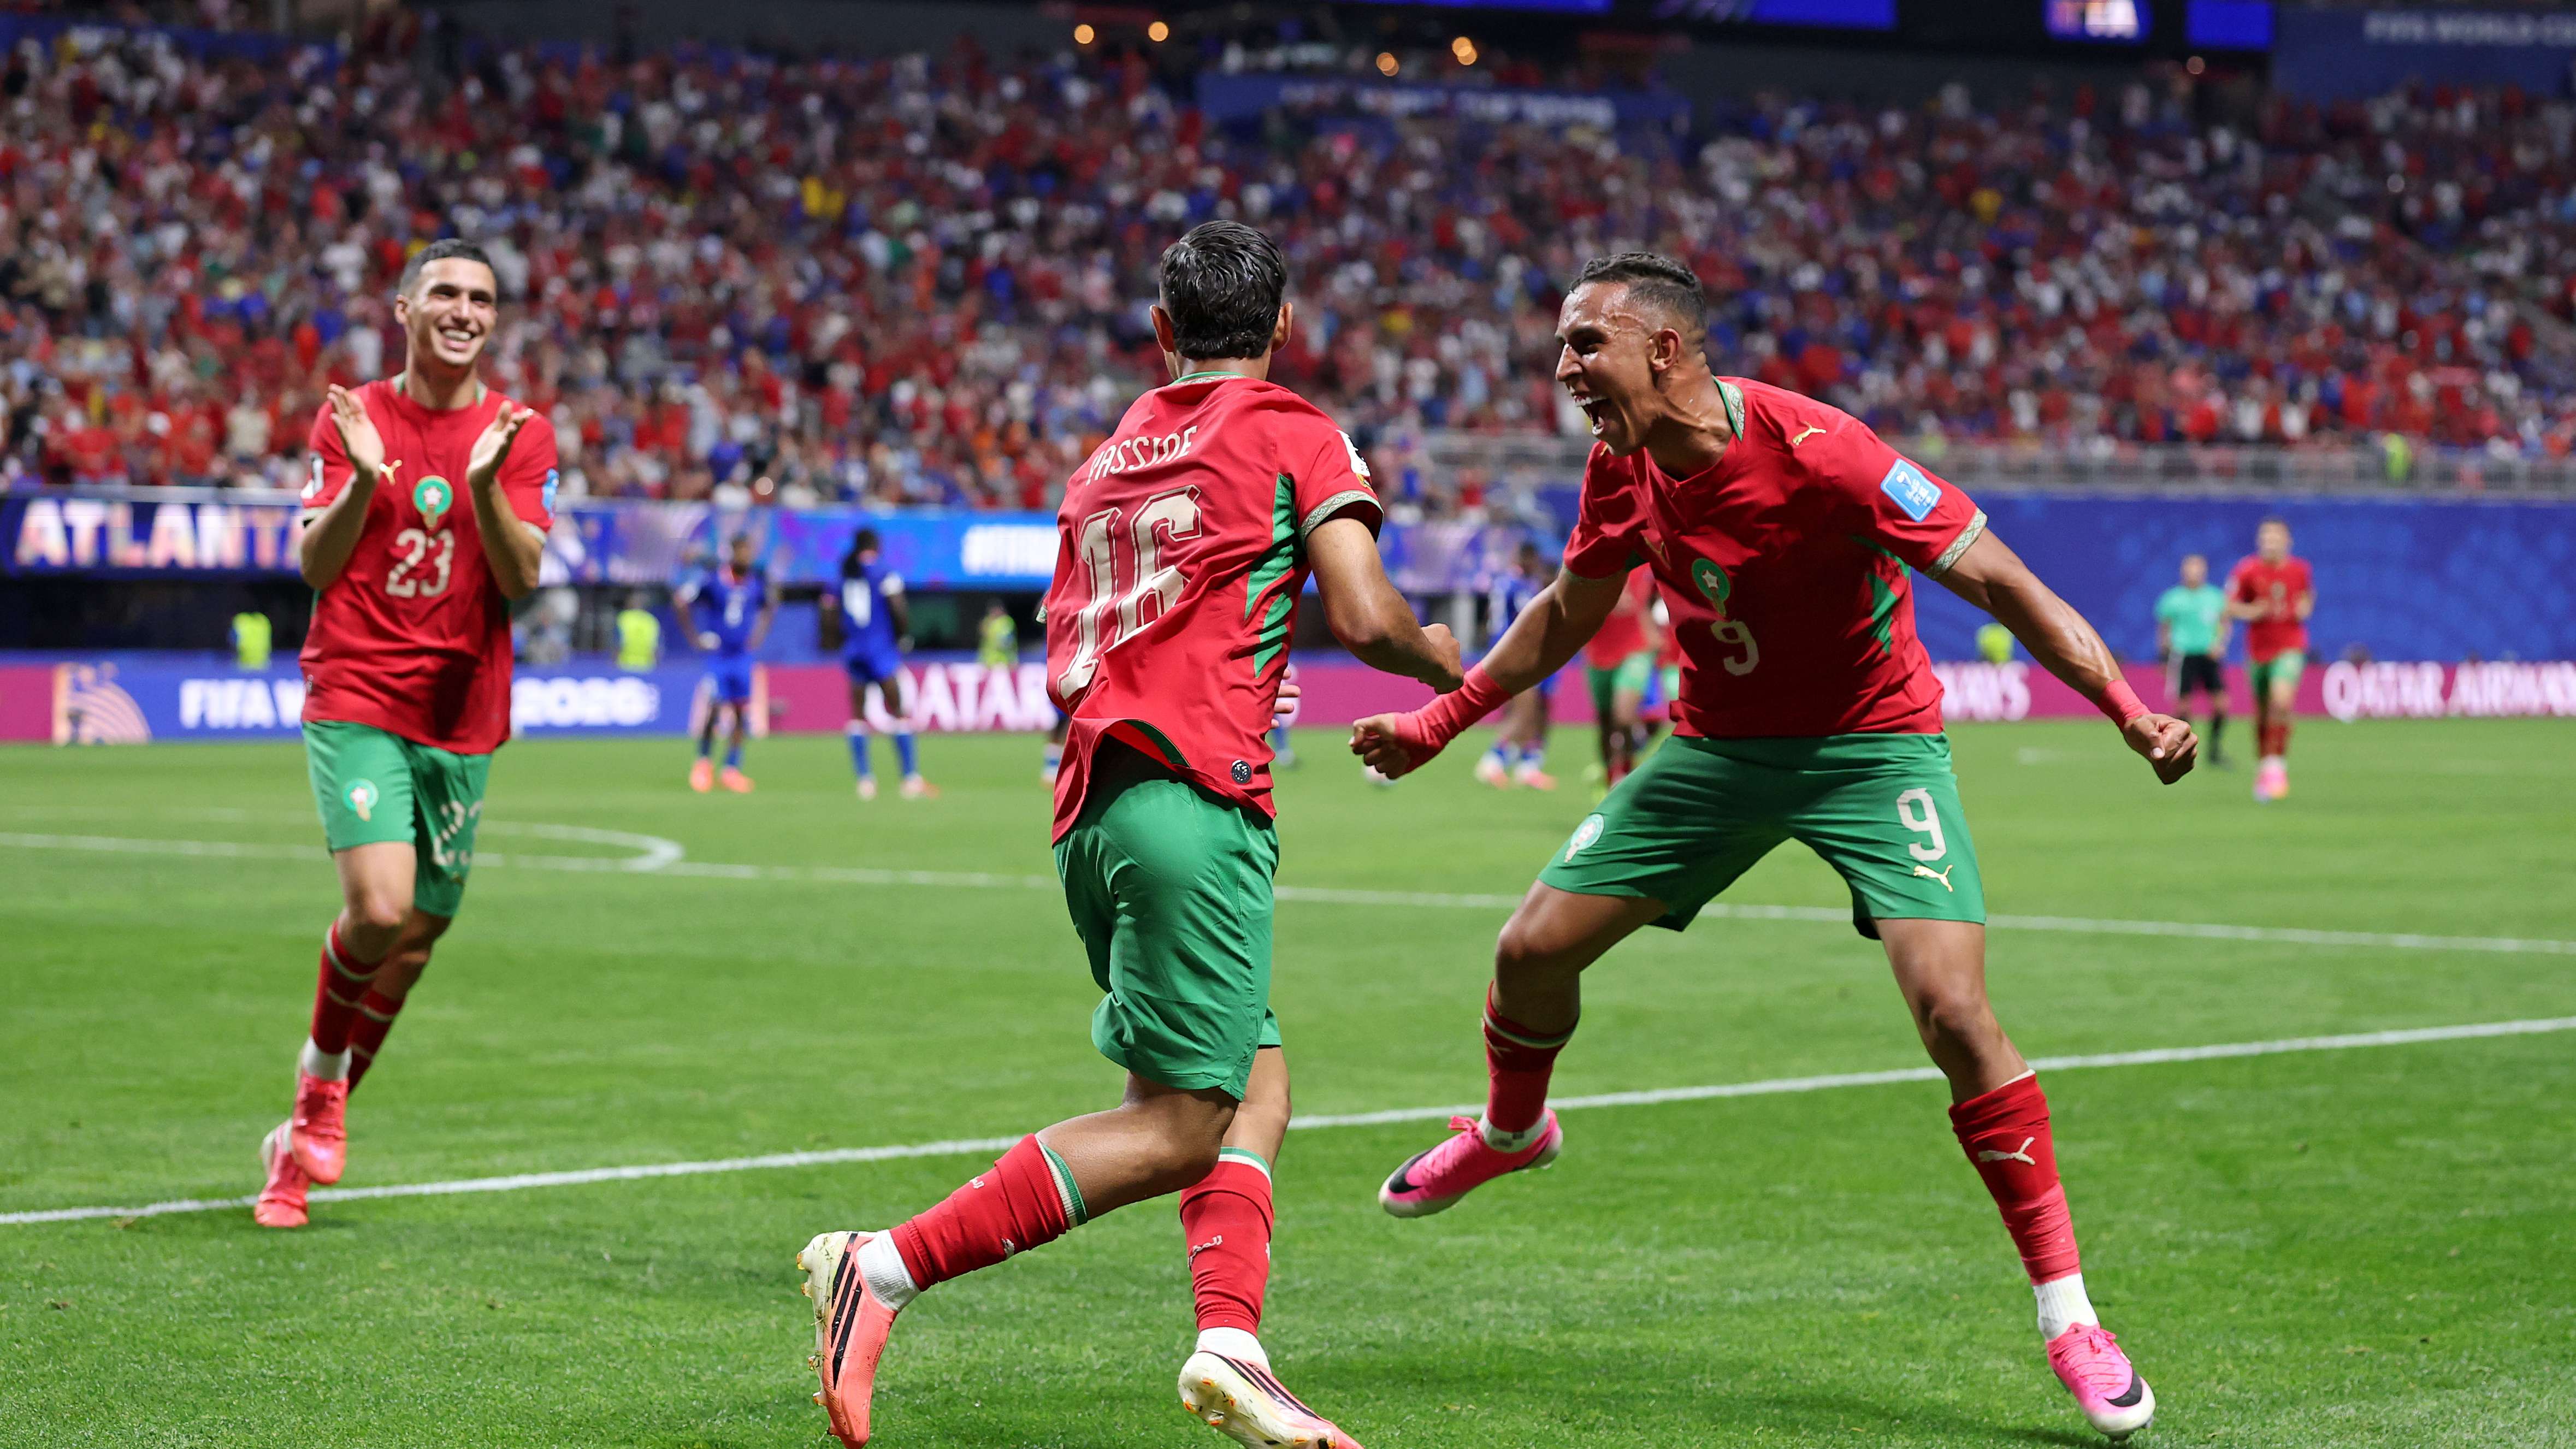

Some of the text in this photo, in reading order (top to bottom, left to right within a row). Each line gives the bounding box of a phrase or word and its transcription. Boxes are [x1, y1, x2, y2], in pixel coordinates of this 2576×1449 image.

[385, 528, 454, 598] 23
[1057, 484, 1202, 705] 16
[1710, 620, 1759, 676] 9
[179, 678, 276, 729] FIFA
[862, 661, 1059, 733] QATAR
[2323, 660, 2576, 723] QATAR AIRWA
[1896, 788, 1947, 861] 9
